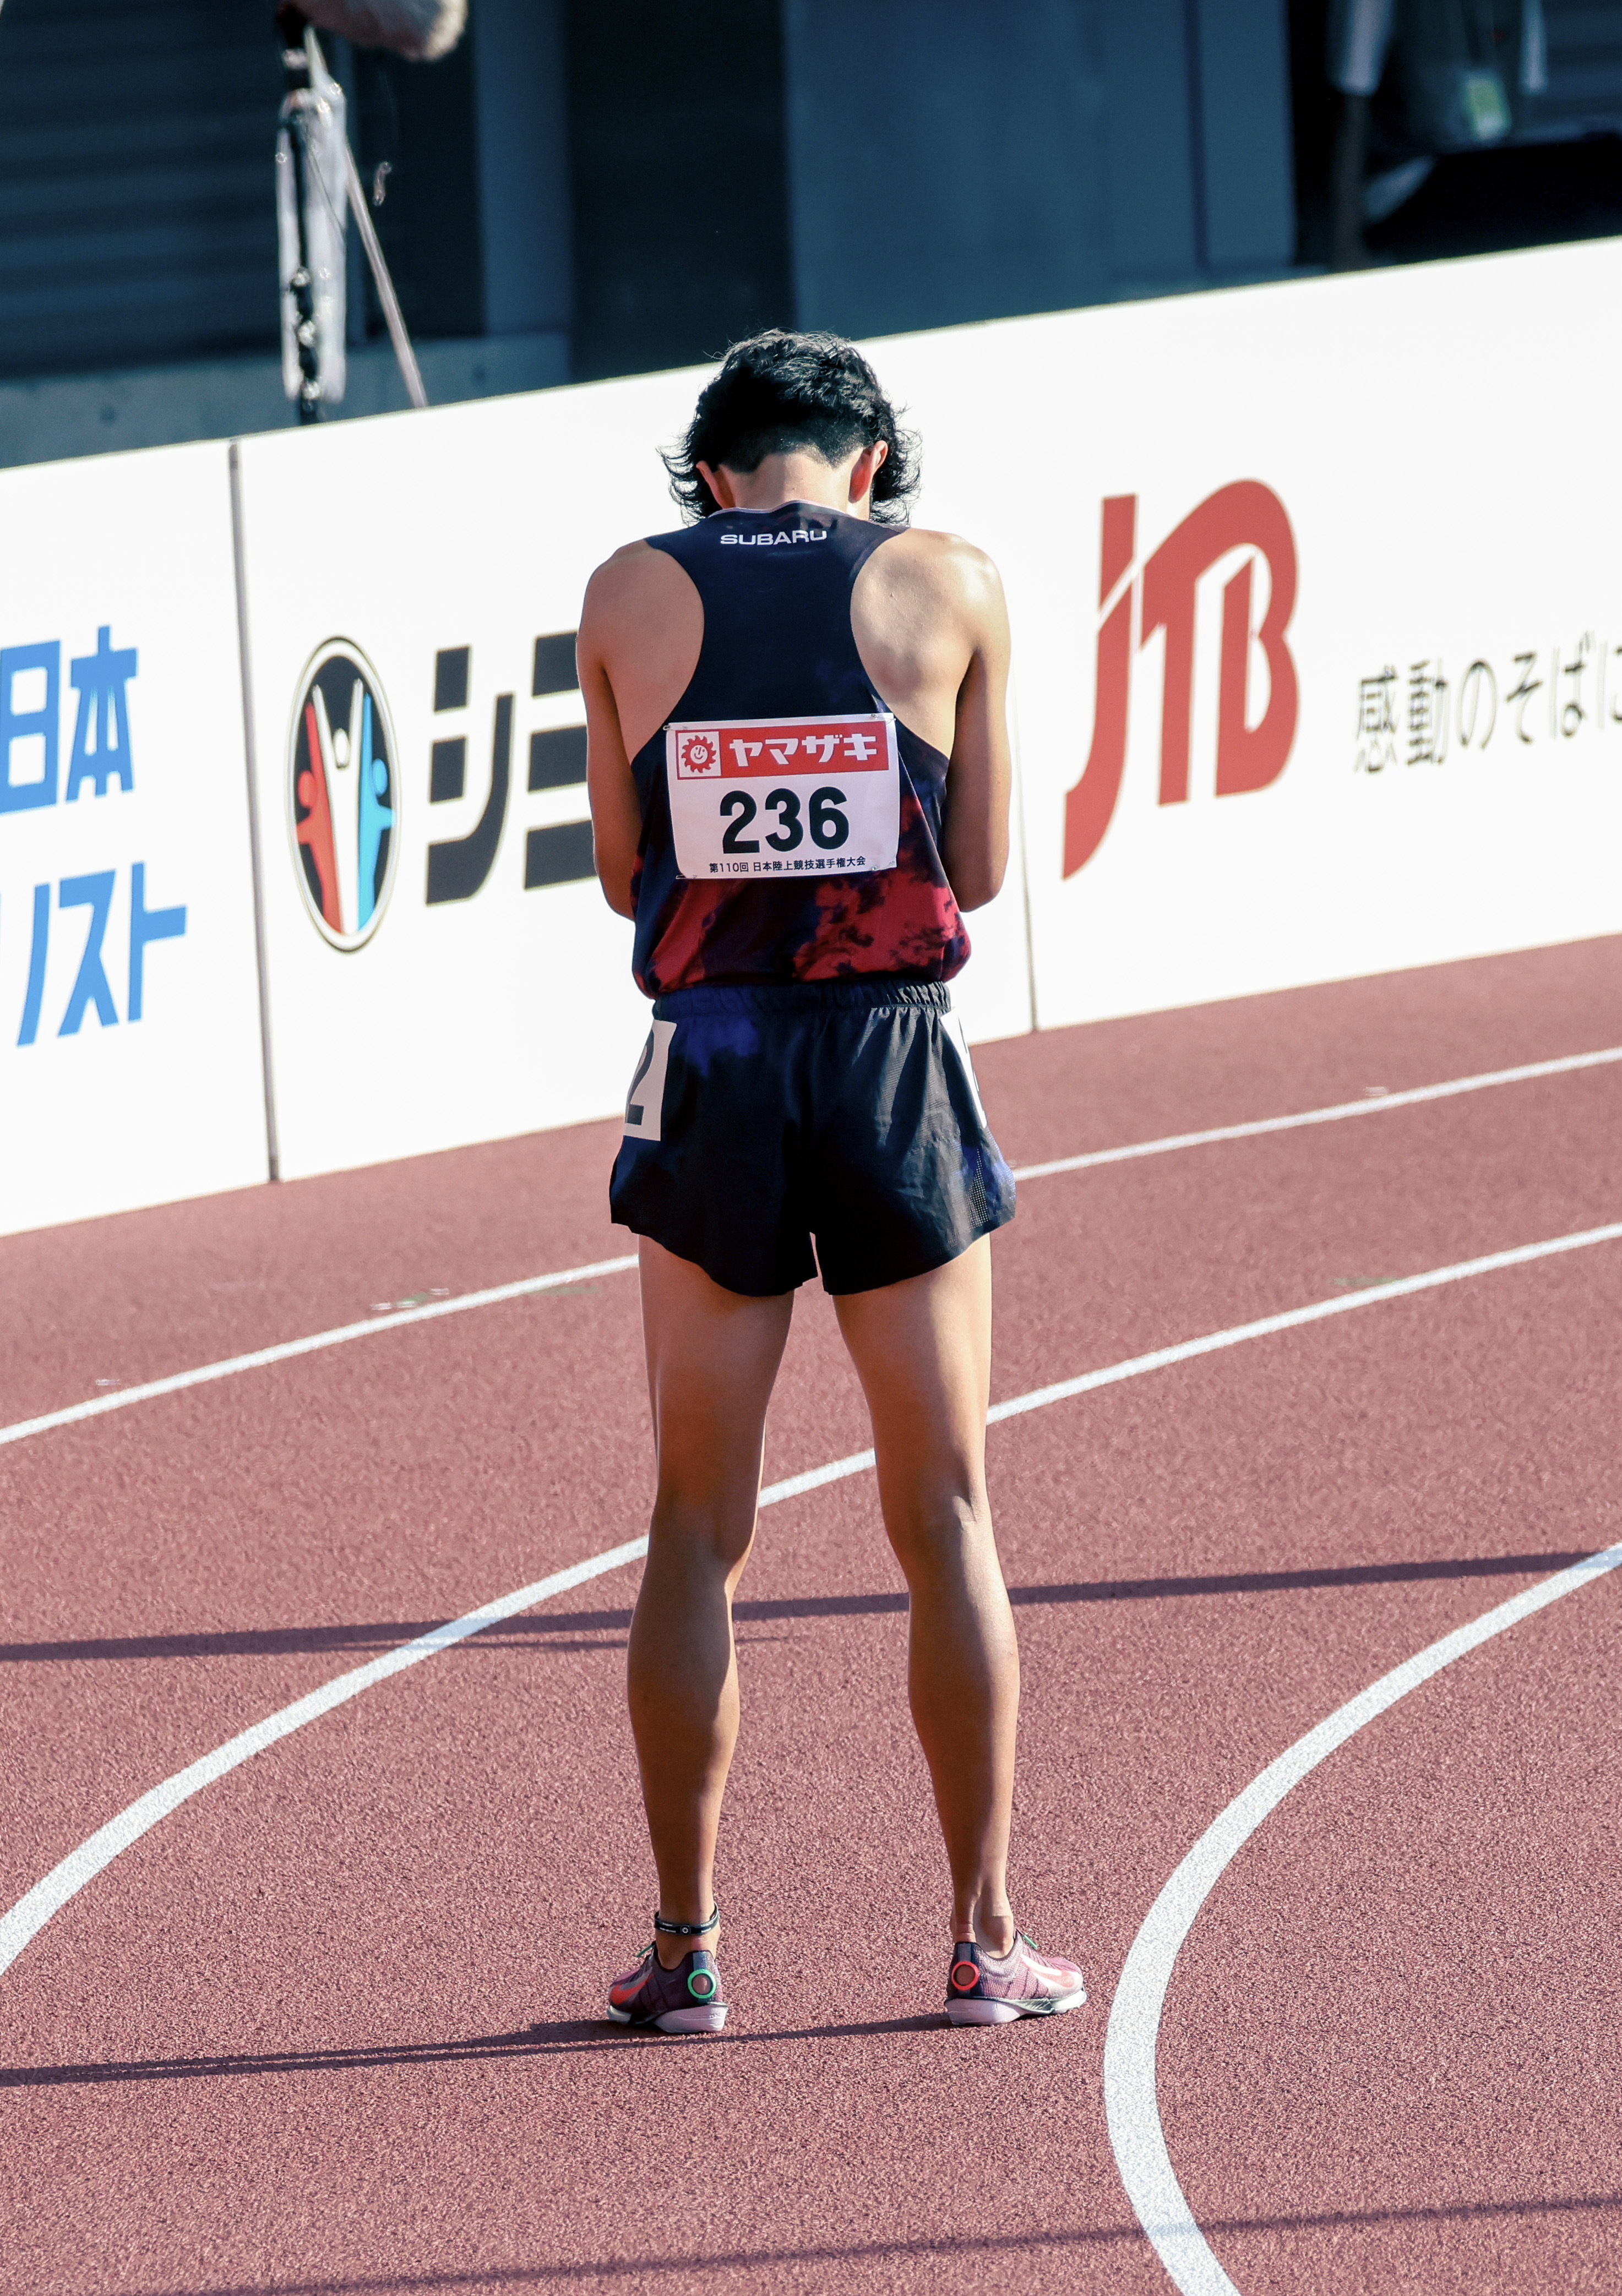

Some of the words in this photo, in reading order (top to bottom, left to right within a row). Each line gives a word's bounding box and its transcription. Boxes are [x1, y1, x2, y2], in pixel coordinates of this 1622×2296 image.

[720, 530, 827, 546] SUBARU
[1062, 478, 1299, 881] JTB
[729, 733, 878, 767] ヤマザキ
[720, 786, 849, 854] 236
[709, 863, 749, 873] 第110回
[753, 855, 866, 872] 日本陸上競技選手権大会
